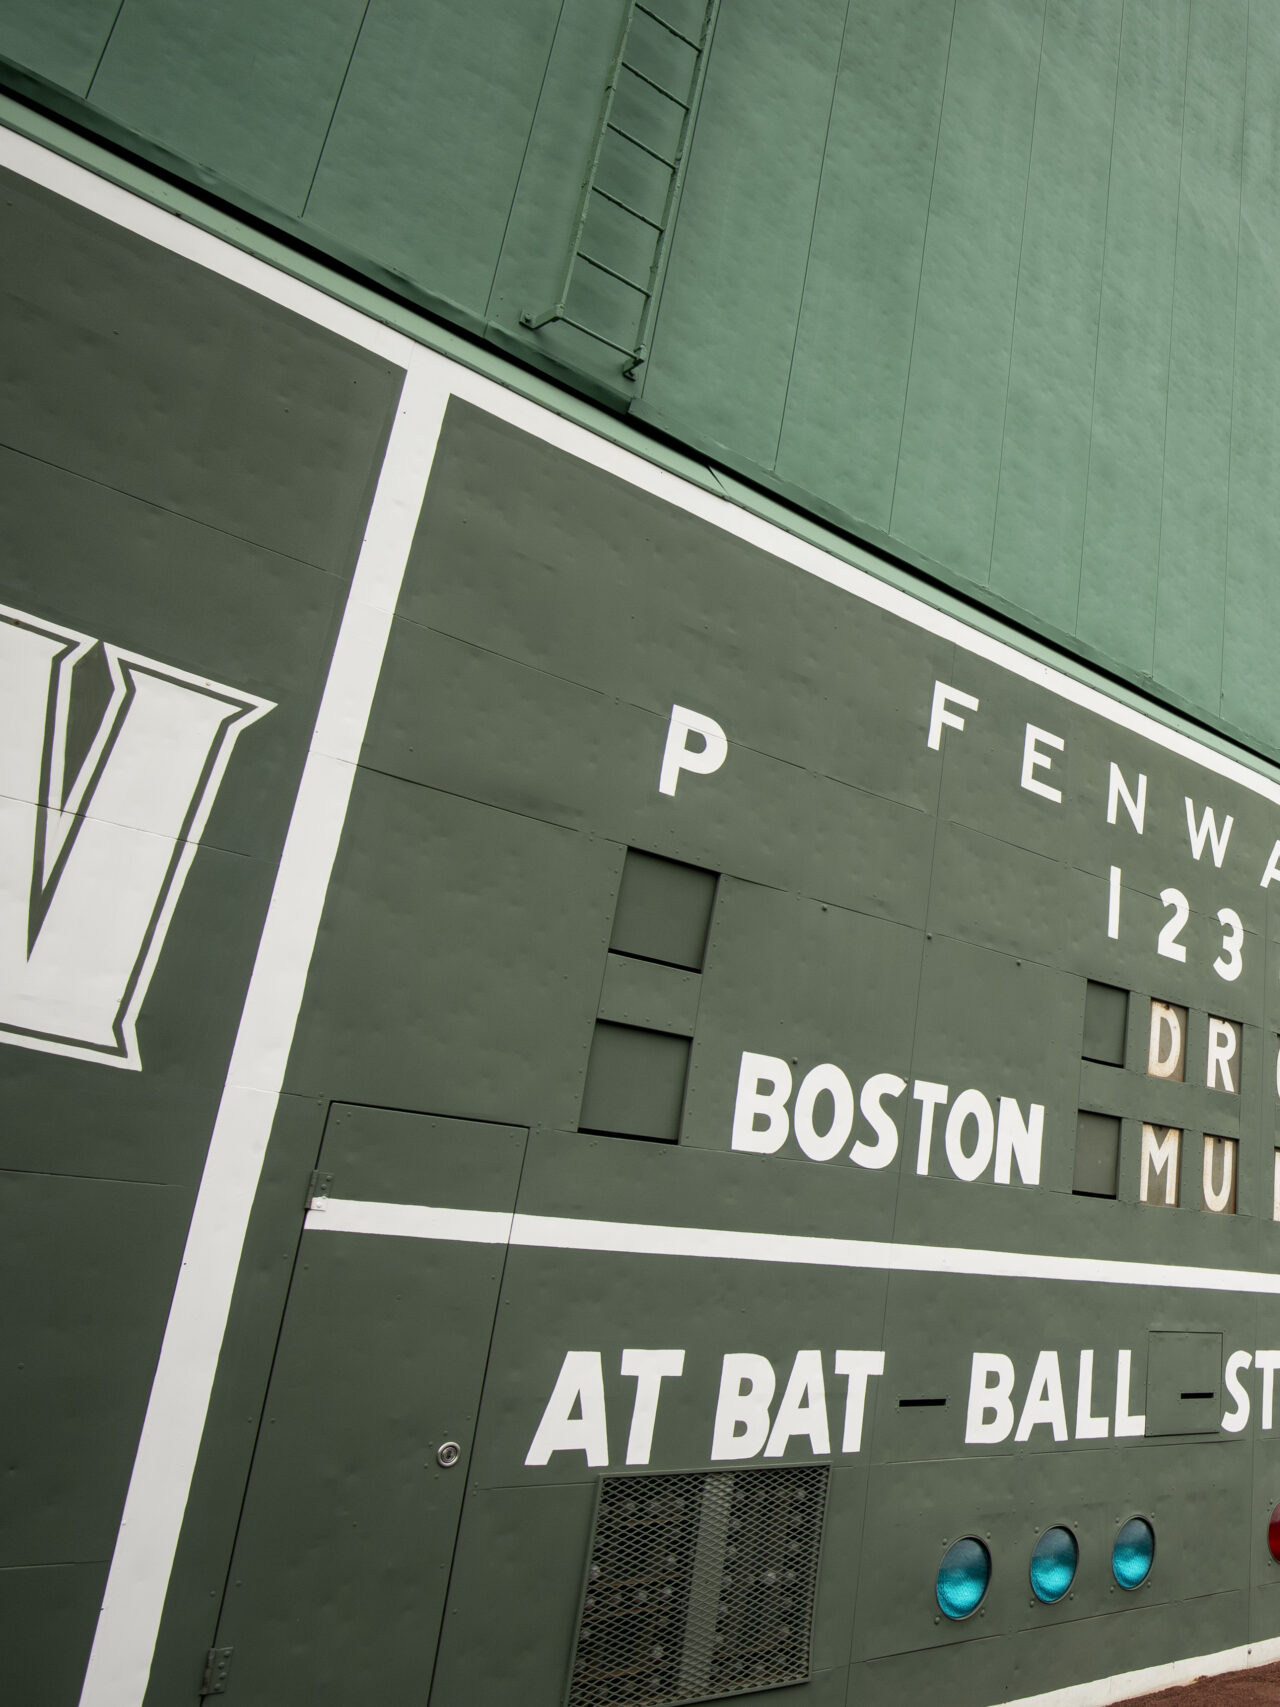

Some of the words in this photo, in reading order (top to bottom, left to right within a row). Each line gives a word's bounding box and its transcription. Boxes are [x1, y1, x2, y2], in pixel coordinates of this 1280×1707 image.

[659, 704, 728, 797] P
[731, 1051, 1045, 1185] BOSTON
[524, 1349, 685, 1467] AT
[711, 1350, 885, 1461] BAT
[964, 1348, 1146, 1444] BALL
